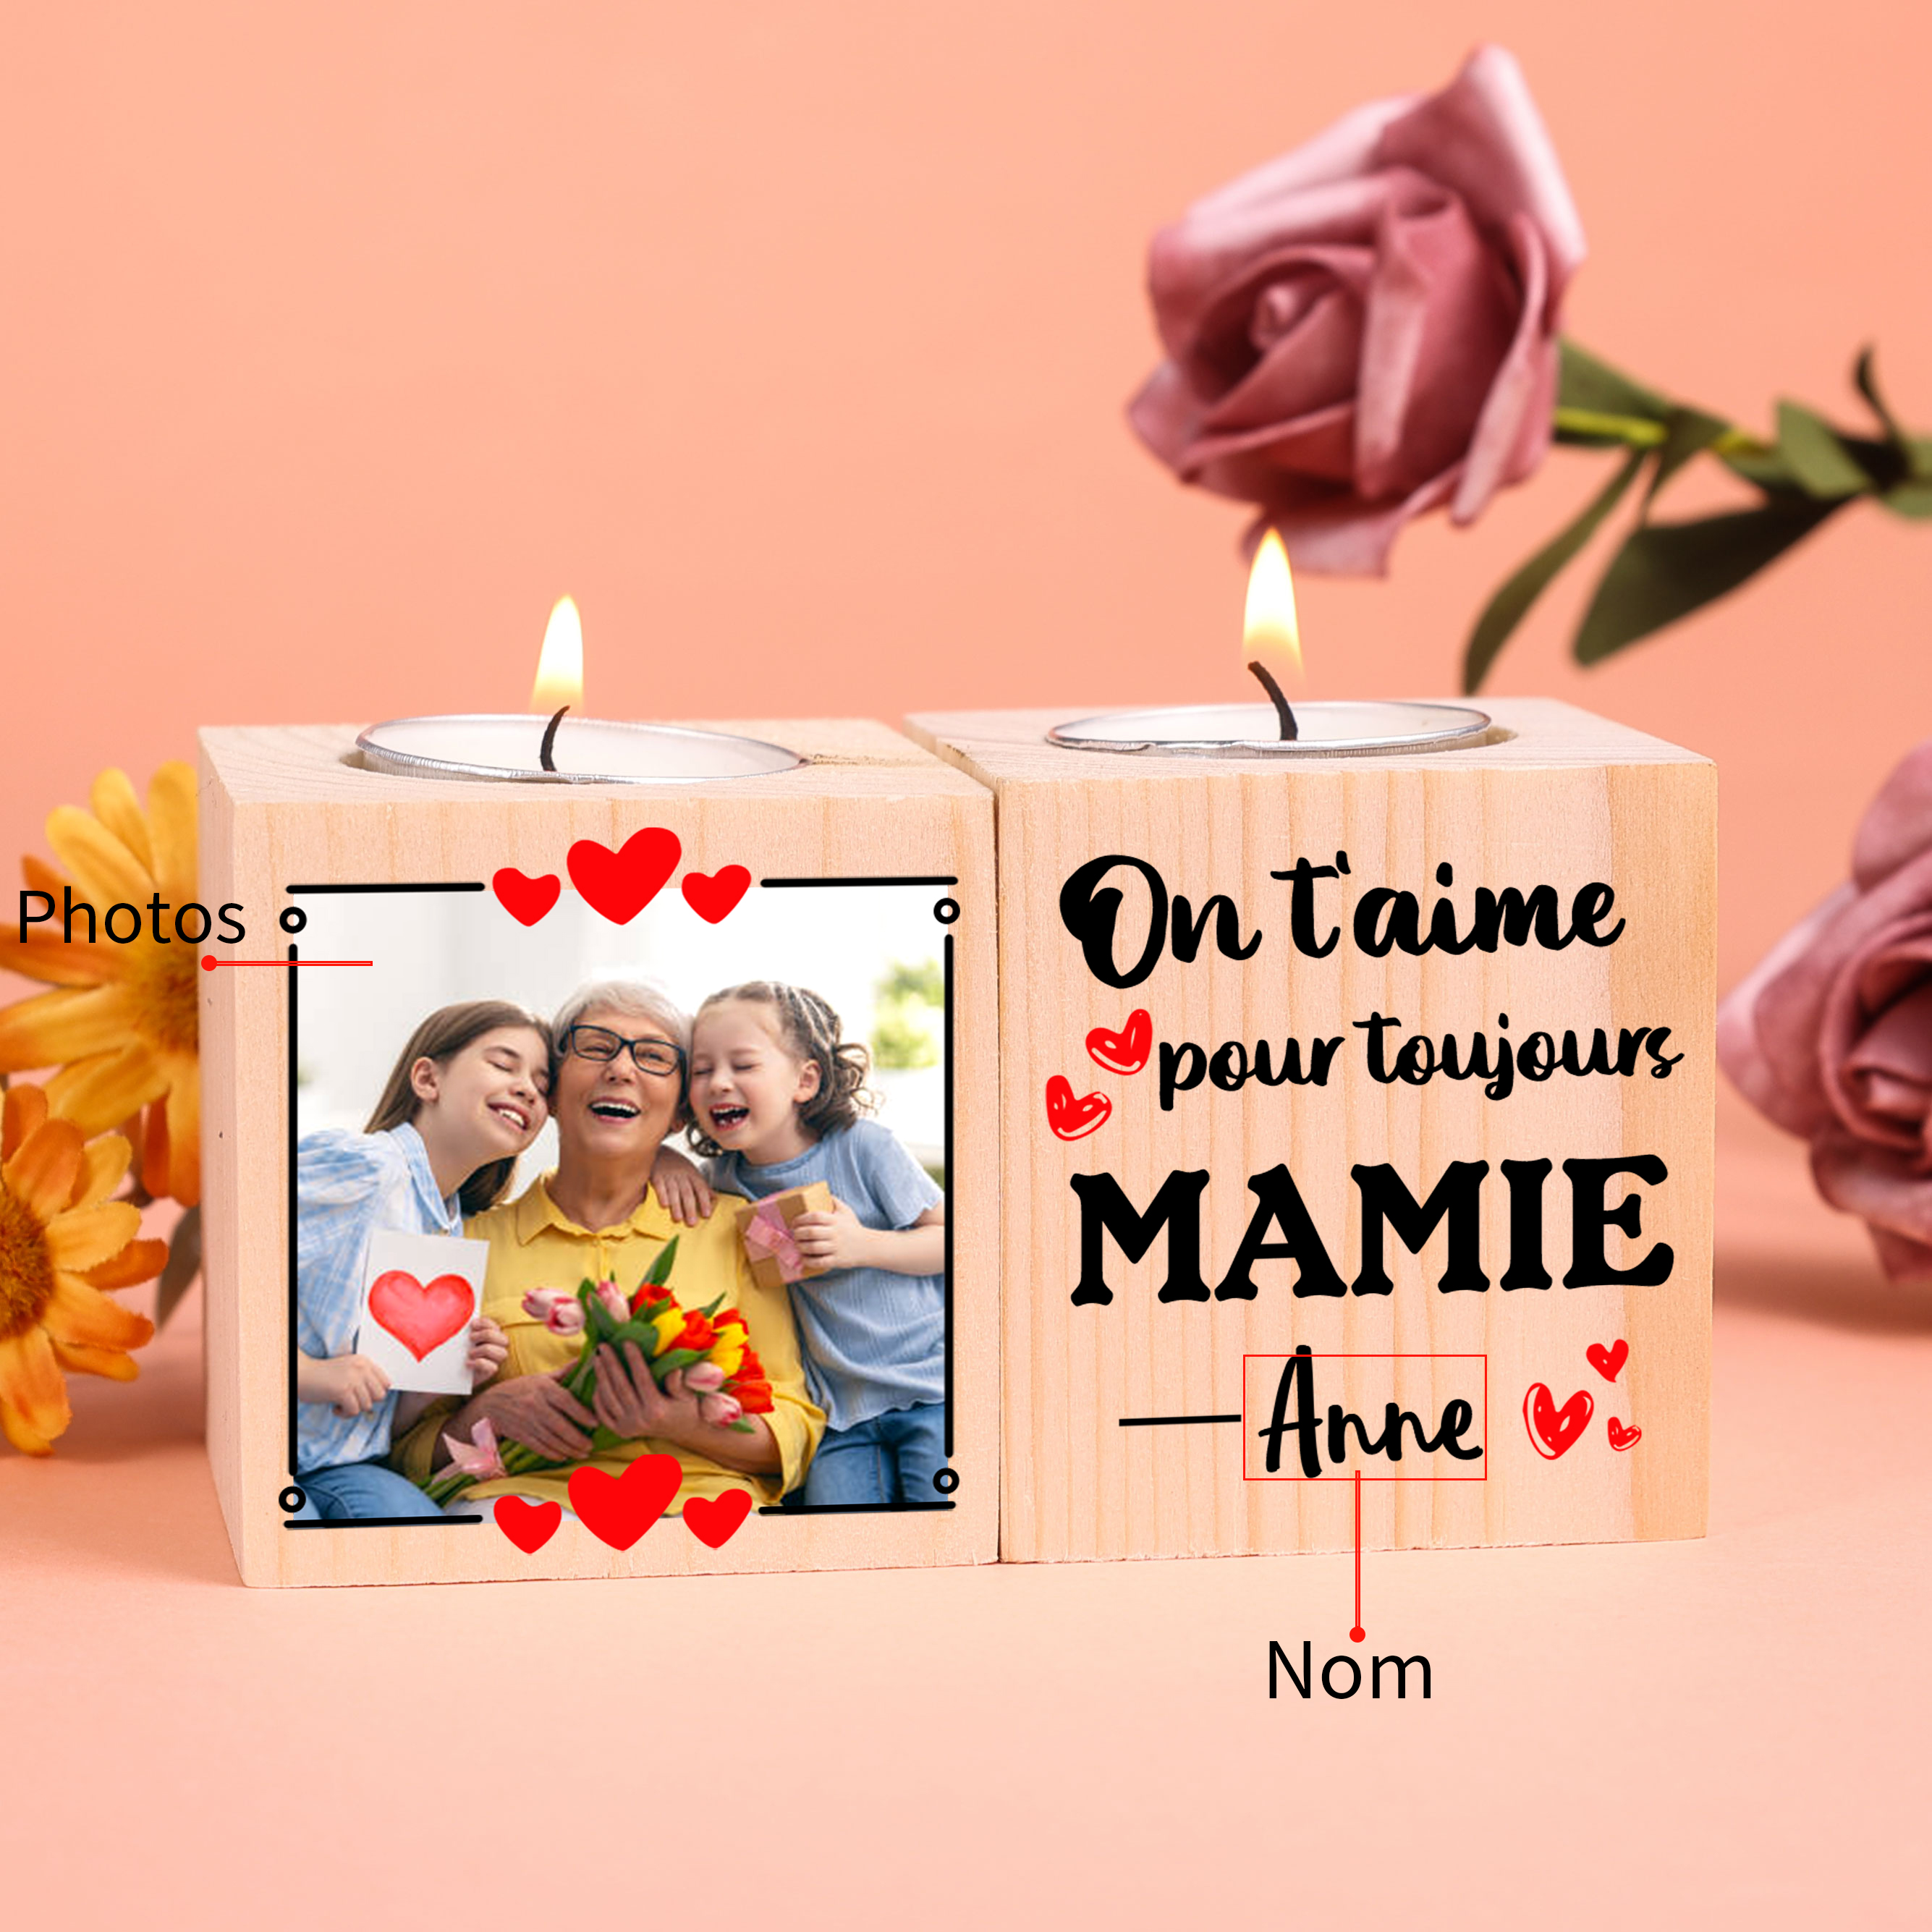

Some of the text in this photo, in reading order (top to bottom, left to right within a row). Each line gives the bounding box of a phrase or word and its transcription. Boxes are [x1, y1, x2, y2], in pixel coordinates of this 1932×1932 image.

[1059, 850, 1627, 990] On t'aime
[1158, 1011, 1686, 1112] pour toujours
[1069, 1153, 1675, 1308] MAMIE
[1257, 1344, 1483, 1478] Anne
